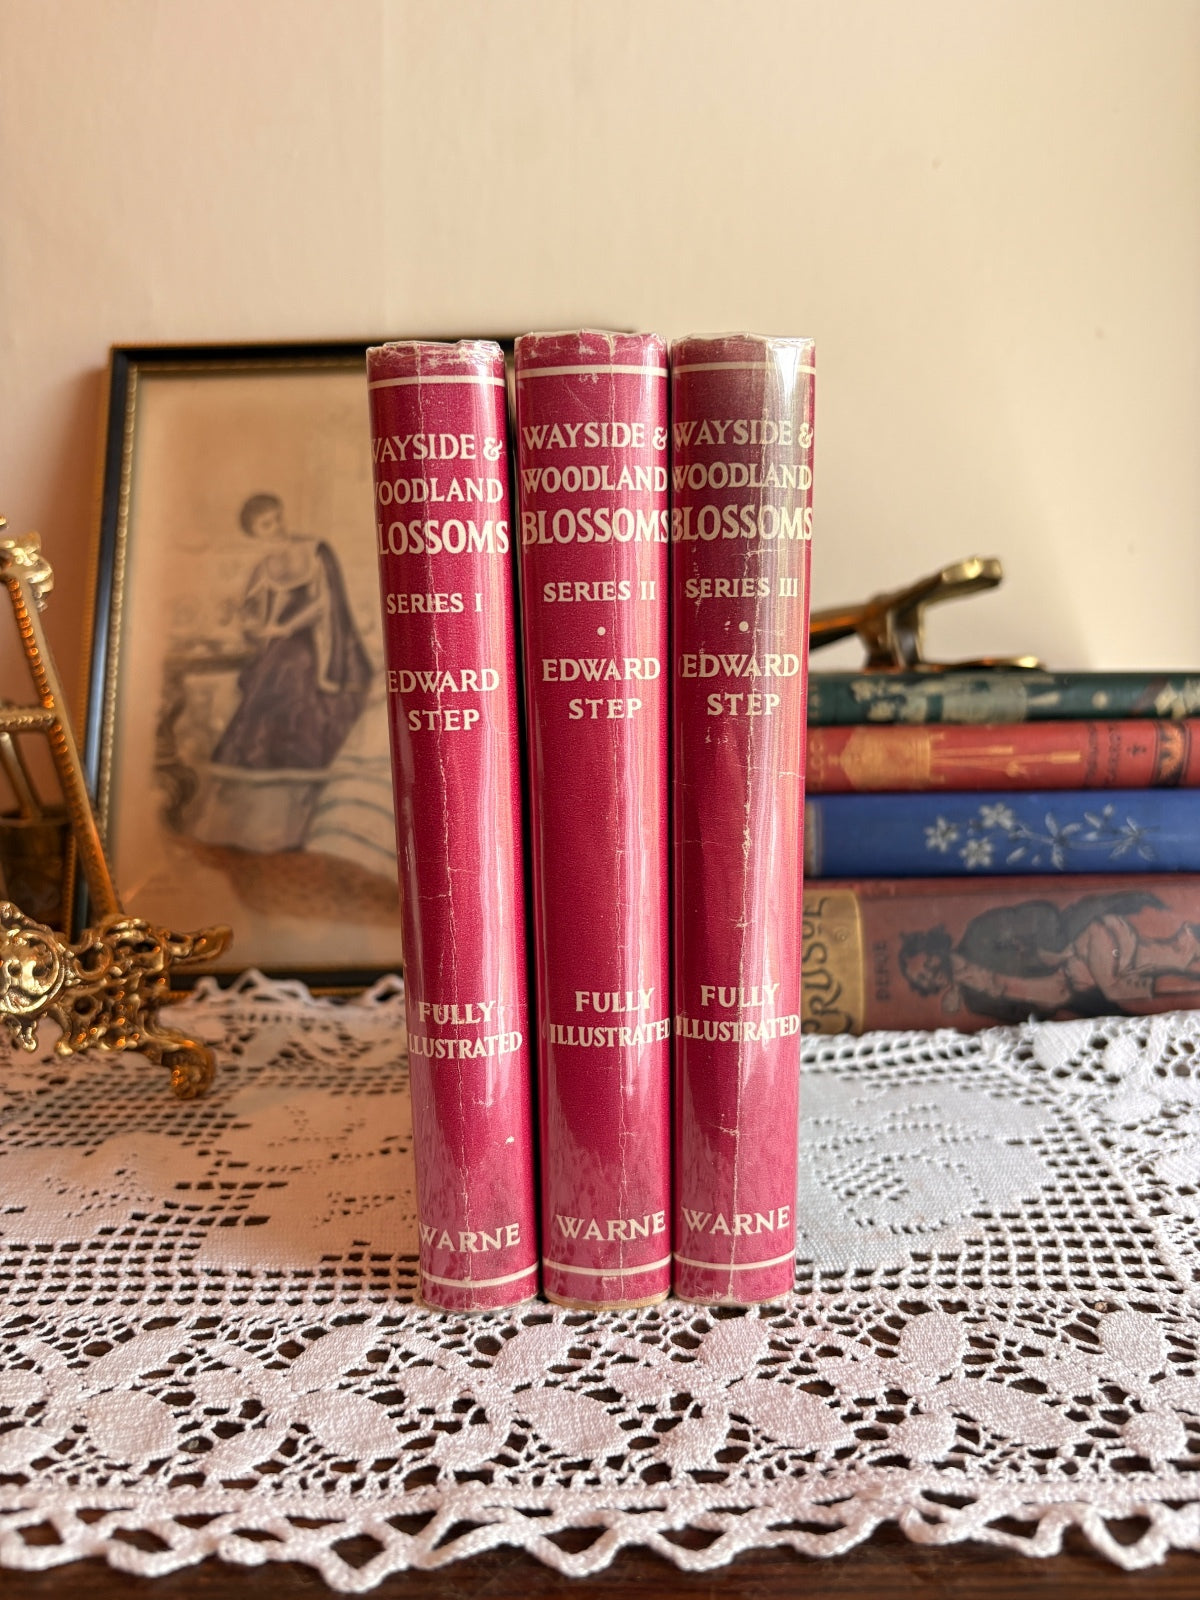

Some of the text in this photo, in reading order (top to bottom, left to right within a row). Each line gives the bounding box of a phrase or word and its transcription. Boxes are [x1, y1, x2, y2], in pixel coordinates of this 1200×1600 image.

[521, 422, 668, 450] WAYSIDE &
[673, 419, 813, 448] WAYSIDE &
[483, 440, 502, 462] &
[521, 466, 668, 493] WOODLAND
[672, 462, 812, 490] WOODLAND
[375, 477, 504, 506] OODLAND
[521, 507, 669, 545] BLOSSOMS
[671, 504, 812, 542] BLOSSOMS
[378, 519, 509, 555] LOSSOMS
[543, 581, 656, 603] SERIES II
[685, 578, 798, 598] SERIES III
[386, 593, 483, 615] SERIES I
[541, 657, 661, 682] EDWARD
[681, 653, 800, 679] EDWARD
[387, 668, 500, 693] EDWARD
[568, 698, 642, 720] STEP
[706, 693, 780, 716] STEP
[408, 709, 480, 731] STEP
[575, 988, 656, 1012] FULLY
[700, 984, 780, 1008] FULLY
[418, 1000, 496, 1025] FULLY
[549, 1017, 671, 1048] ILLUSTRATED
[676, 1014, 800, 1043] ILLUSTRATED
[408, 1031, 522, 1060] LLUSTRATED
[555, 1210, 666, 1241] WARNE
[681, 1204, 792, 1236] WARNE
[419, 1222, 520, 1253] WARNE
